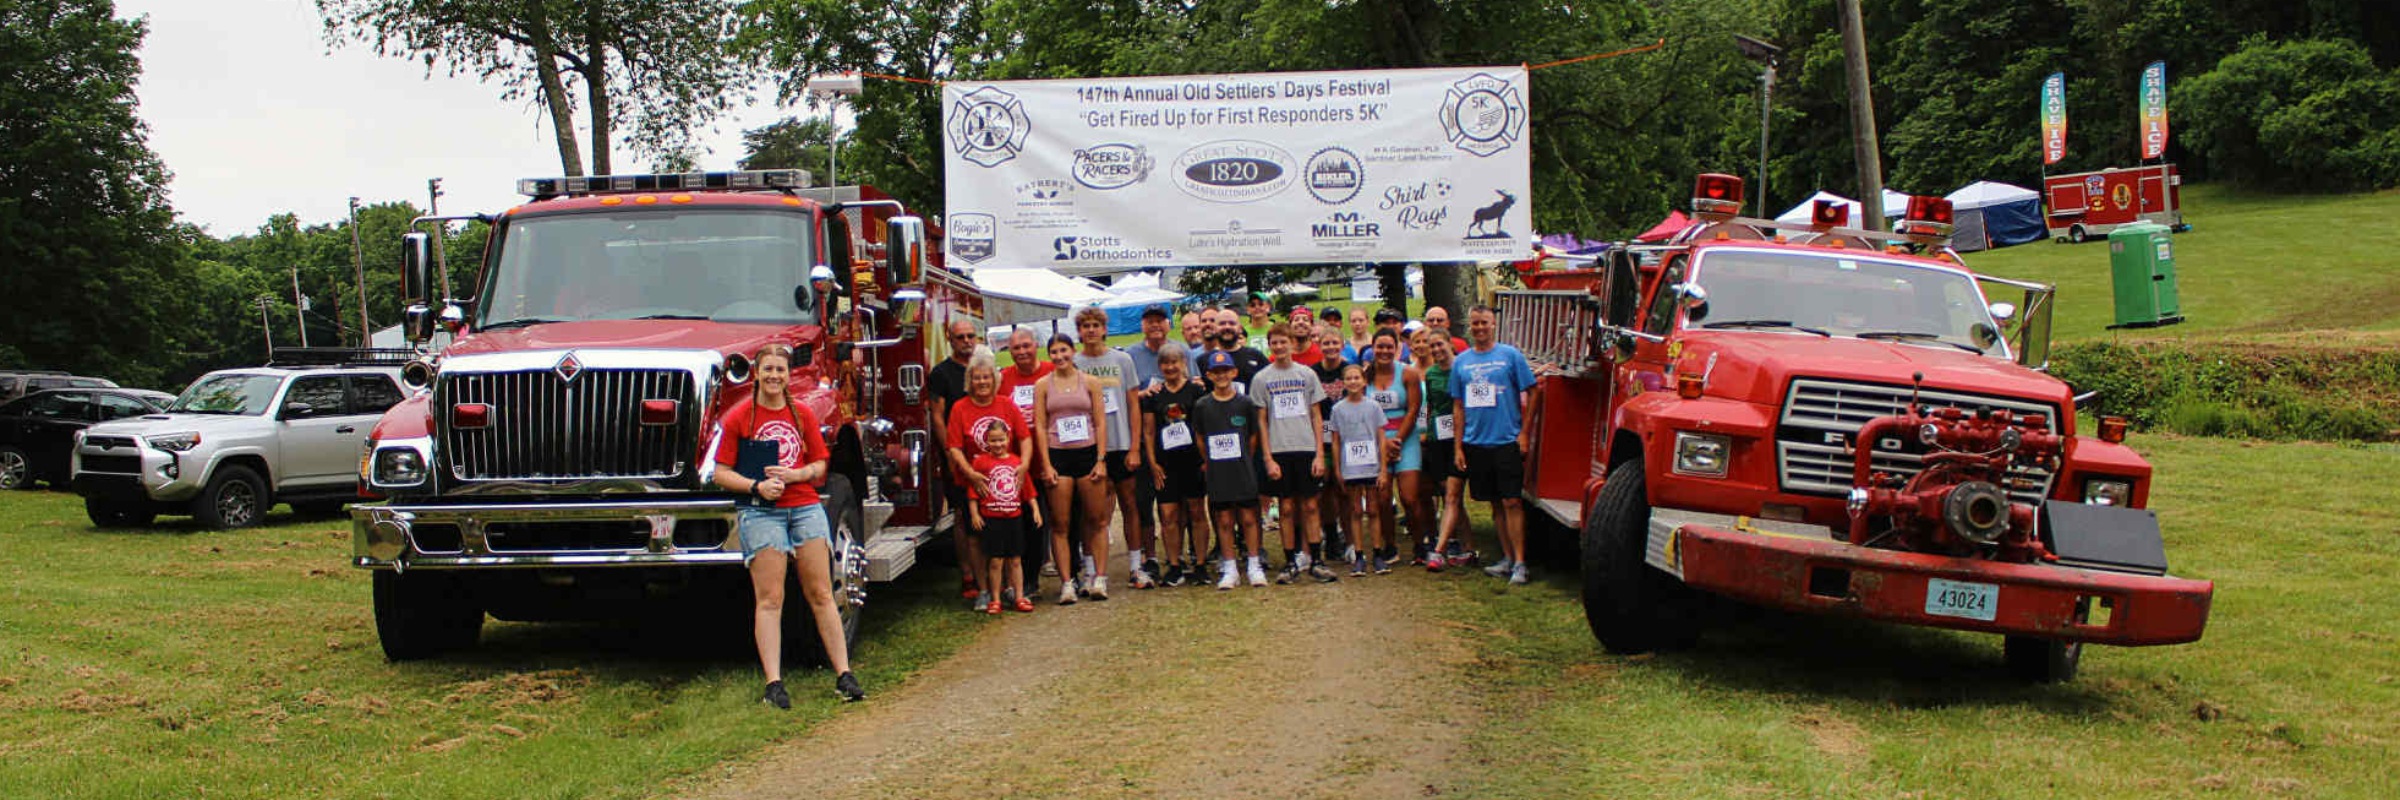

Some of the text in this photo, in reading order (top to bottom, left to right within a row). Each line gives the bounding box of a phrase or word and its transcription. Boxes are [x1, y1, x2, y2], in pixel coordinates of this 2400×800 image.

[1077, 78, 1391, 102] 147th Annual Old Settlers' Days Festival
[1472, 96, 1490, 108] 5K
[2146, 67, 2161, 156] SHAVE ICE
[1120, 109, 1159, 127] Fired
[1164, 108, 1187, 129] Up
[1191, 108, 1213, 125] for
[1218, 106, 1253, 124] First
[1258, 104, 1354, 127] Responders
[2047, 78, 2062, 161] SHAVE ICE
[1073, 149, 1131, 164] PACERS &
[1082, 163, 1131, 178] RACERS
[1210, 161, 1259, 182] 1820
[1379, 181, 1427, 210] Shirt
[1397, 205, 1447, 230] Rags
[1312, 223, 1380, 237] MILLER
[1080, 236, 1120, 246] Stotts
[1080, 247, 1172, 260] Orthodontics
[1063, 420, 1082, 432] 954
[1938, 589, 1987, 611] 43024
